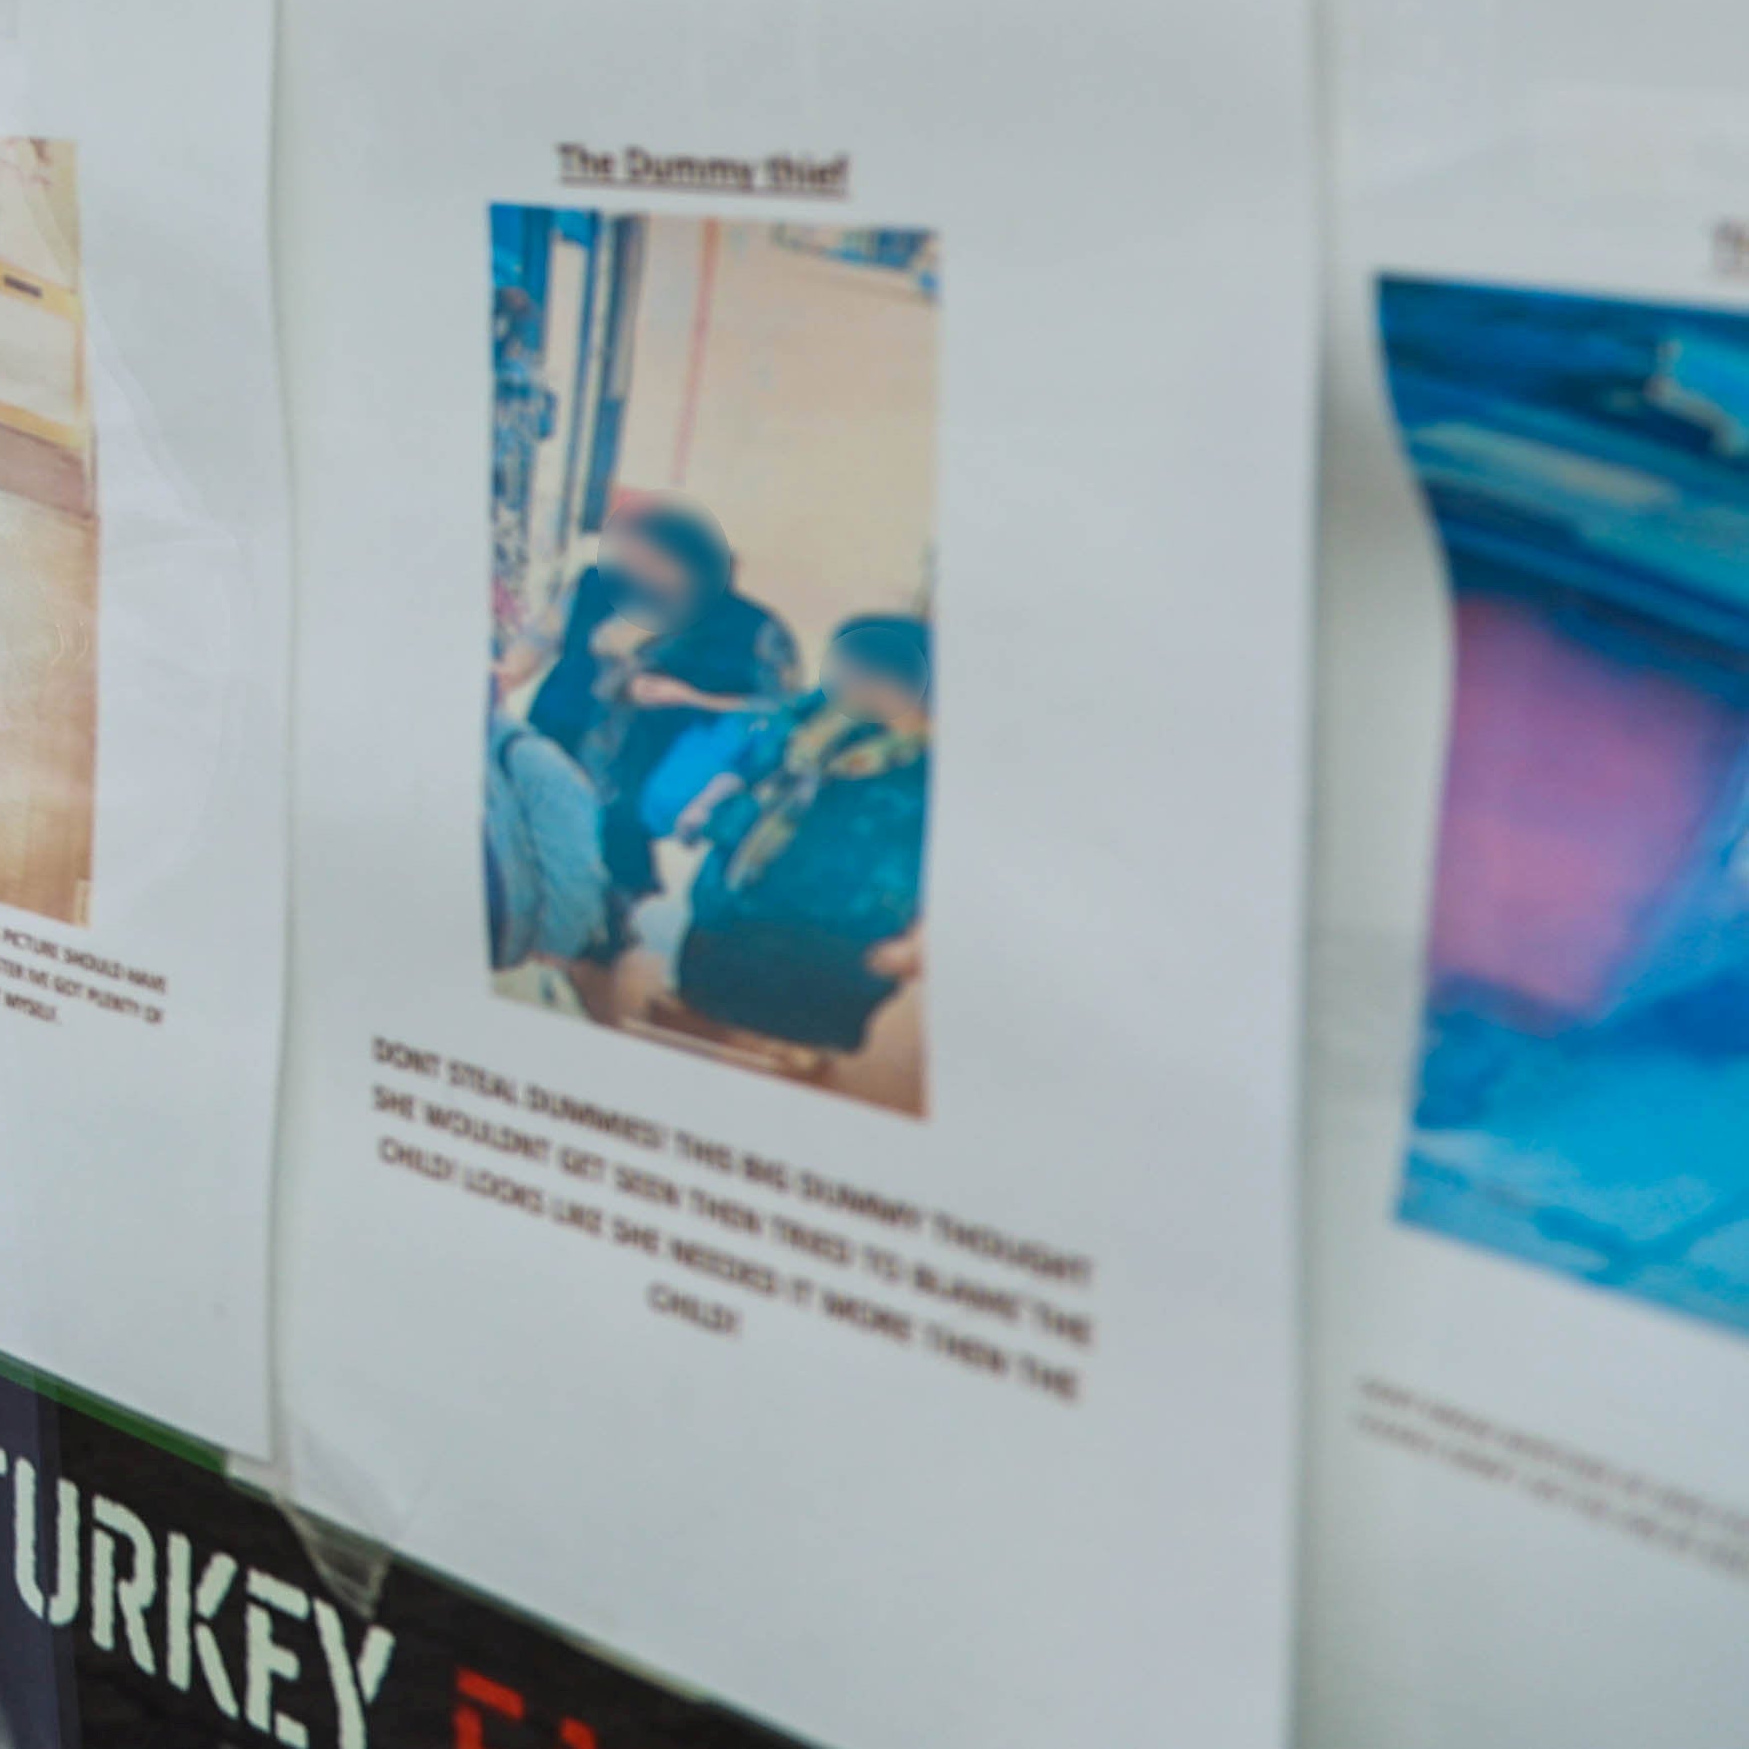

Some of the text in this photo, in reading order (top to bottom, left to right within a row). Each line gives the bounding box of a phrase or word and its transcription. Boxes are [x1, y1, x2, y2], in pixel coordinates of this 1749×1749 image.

[557, 143, 848, 194] The Dummy thief
